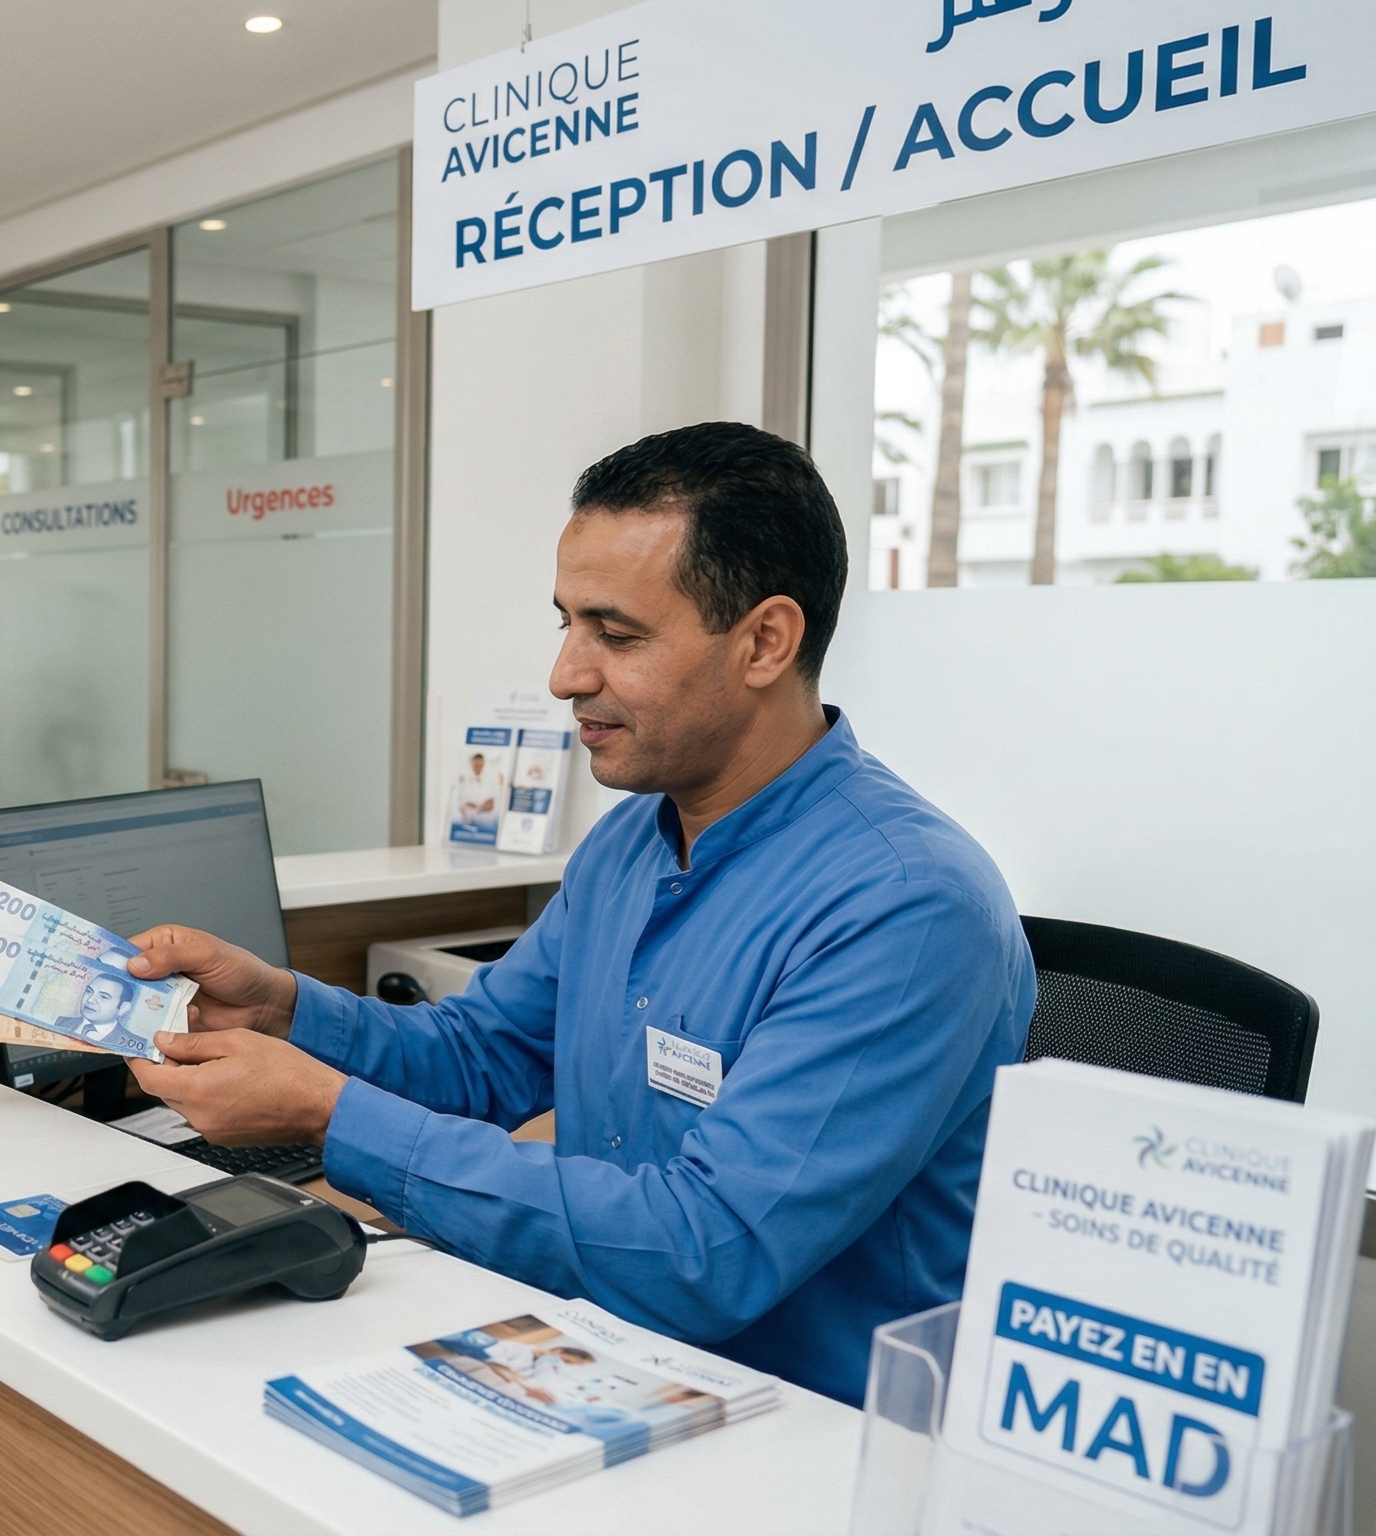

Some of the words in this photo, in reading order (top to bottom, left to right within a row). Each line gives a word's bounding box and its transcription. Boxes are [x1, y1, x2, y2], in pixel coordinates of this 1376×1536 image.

[443, 38, 640, 134] CLINIQUE
[442, 92, 640, 183] AVICENNE
[455, 130, 819, 269] RÉCEPTION
[840, 105, 876, 192] /
[893, 16, 1307, 171] ACCUEIL
[1, 499, 138, 535] CONSULTATIONS
[226, 484, 335, 521] Urgences
[1182, 1156, 1291, 1194] AVICENNE
[1184, 1136, 1293, 1172] CLINIQUE
[1012, 1168, 1135, 1216] CLINIQUE
[1141, 1199, 1284, 1253] AVICENNE
[1048, 1208, 1121, 1244] SOINS
[1126, 1228, 1160, 1255] DE
[1165, 1238, 1280, 1287] QUALITÉ
[1010, 1298, 1126, 1361] PAYEZ
[1131, 1334, 1187, 1380] EN
[1192, 1352, 1251, 1401] EN
[1000, 1361, 1232, 1499] MAD
